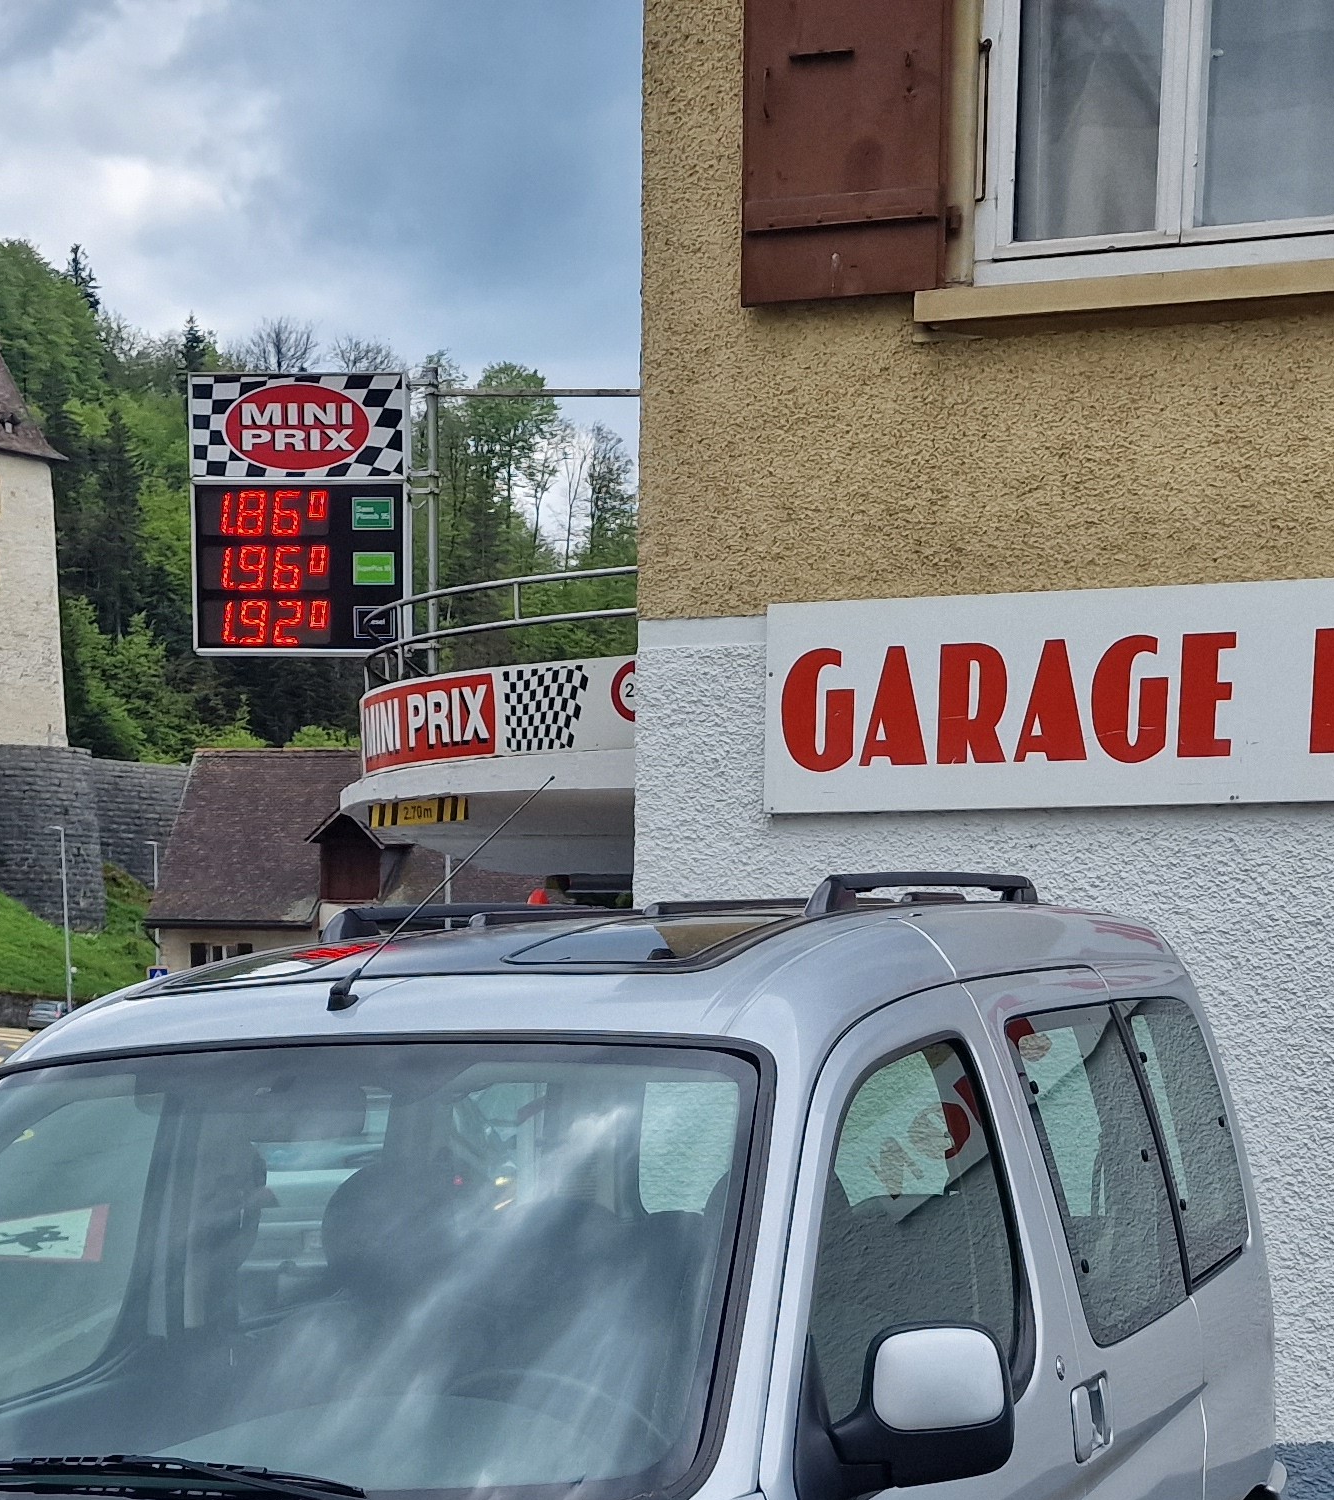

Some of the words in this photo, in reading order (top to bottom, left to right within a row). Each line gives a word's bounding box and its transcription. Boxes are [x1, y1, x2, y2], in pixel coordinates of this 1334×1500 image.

[241, 402, 353, 426] MINI
[241, 429, 355, 451] PRIX
[365, 697, 402, 762] MINI
[407, 684, 491, 750] PRIX
[781, 629, 1237, 773] GARAGE
